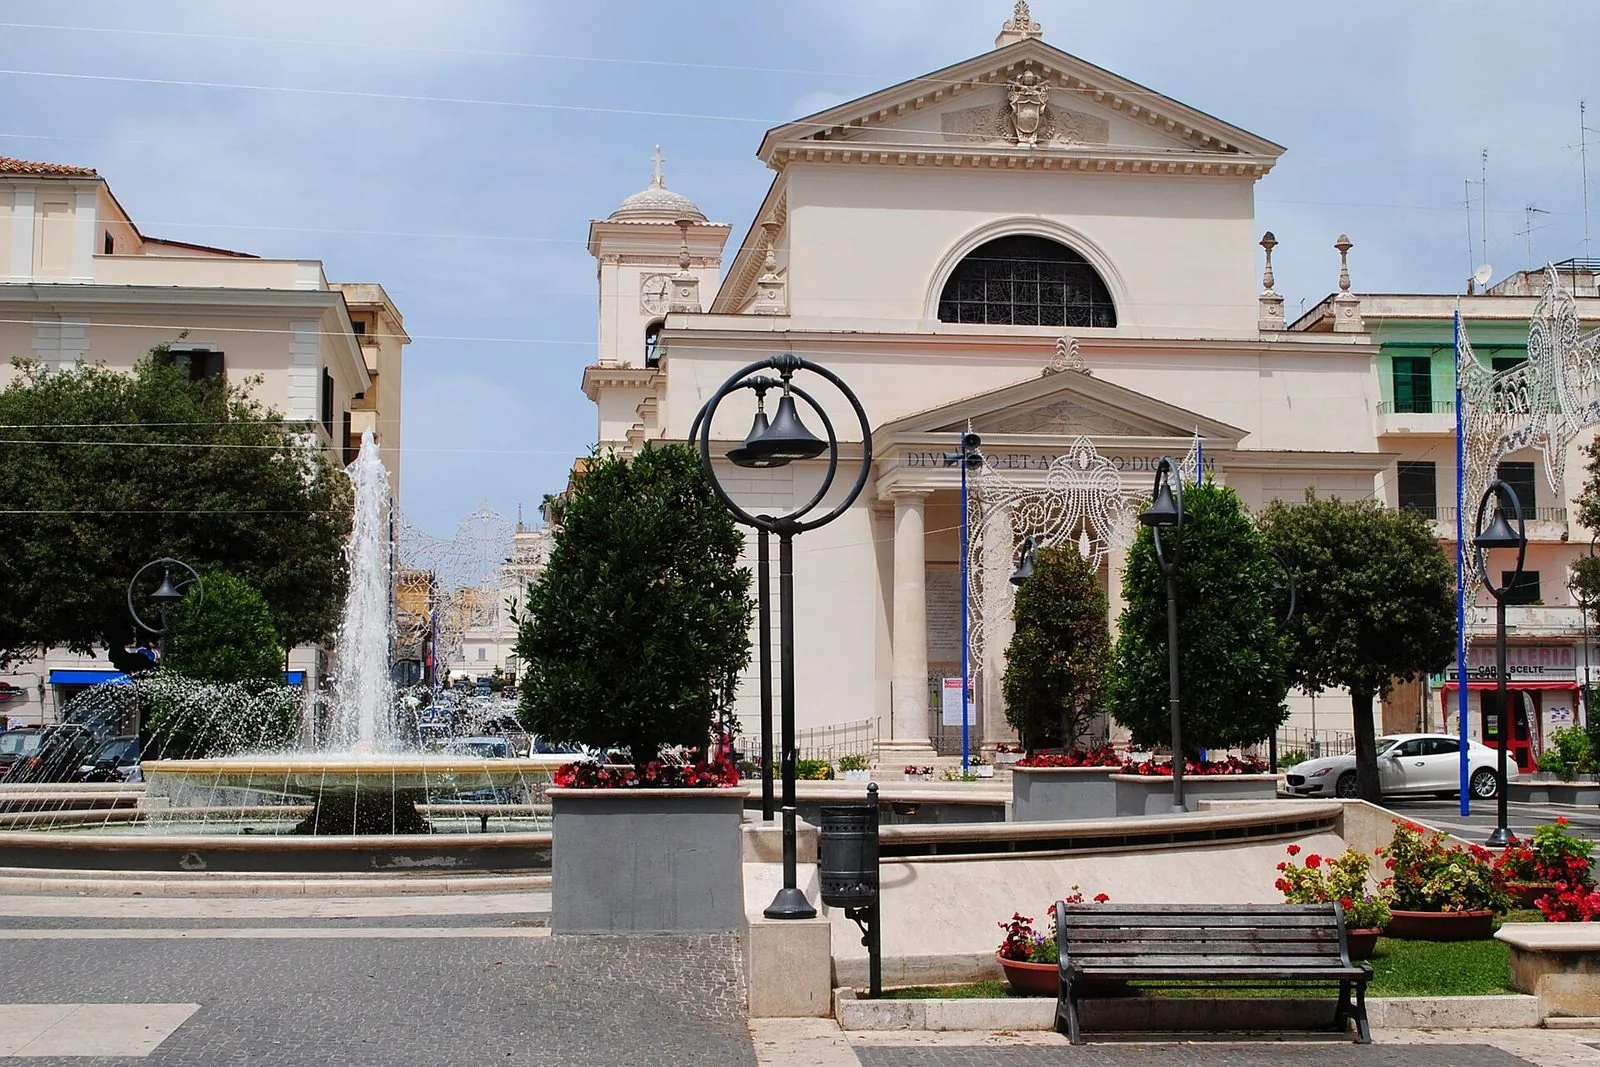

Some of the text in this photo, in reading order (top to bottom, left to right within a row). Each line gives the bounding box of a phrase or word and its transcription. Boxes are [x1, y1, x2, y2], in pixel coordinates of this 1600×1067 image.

[1007, 454, 1032, 468] ET
[1132, 456, 1216, 471] DICTM
[1461, 648, 1572, 665] ACLLERIA
[1509, 665, 1544, 674] SCELTE
